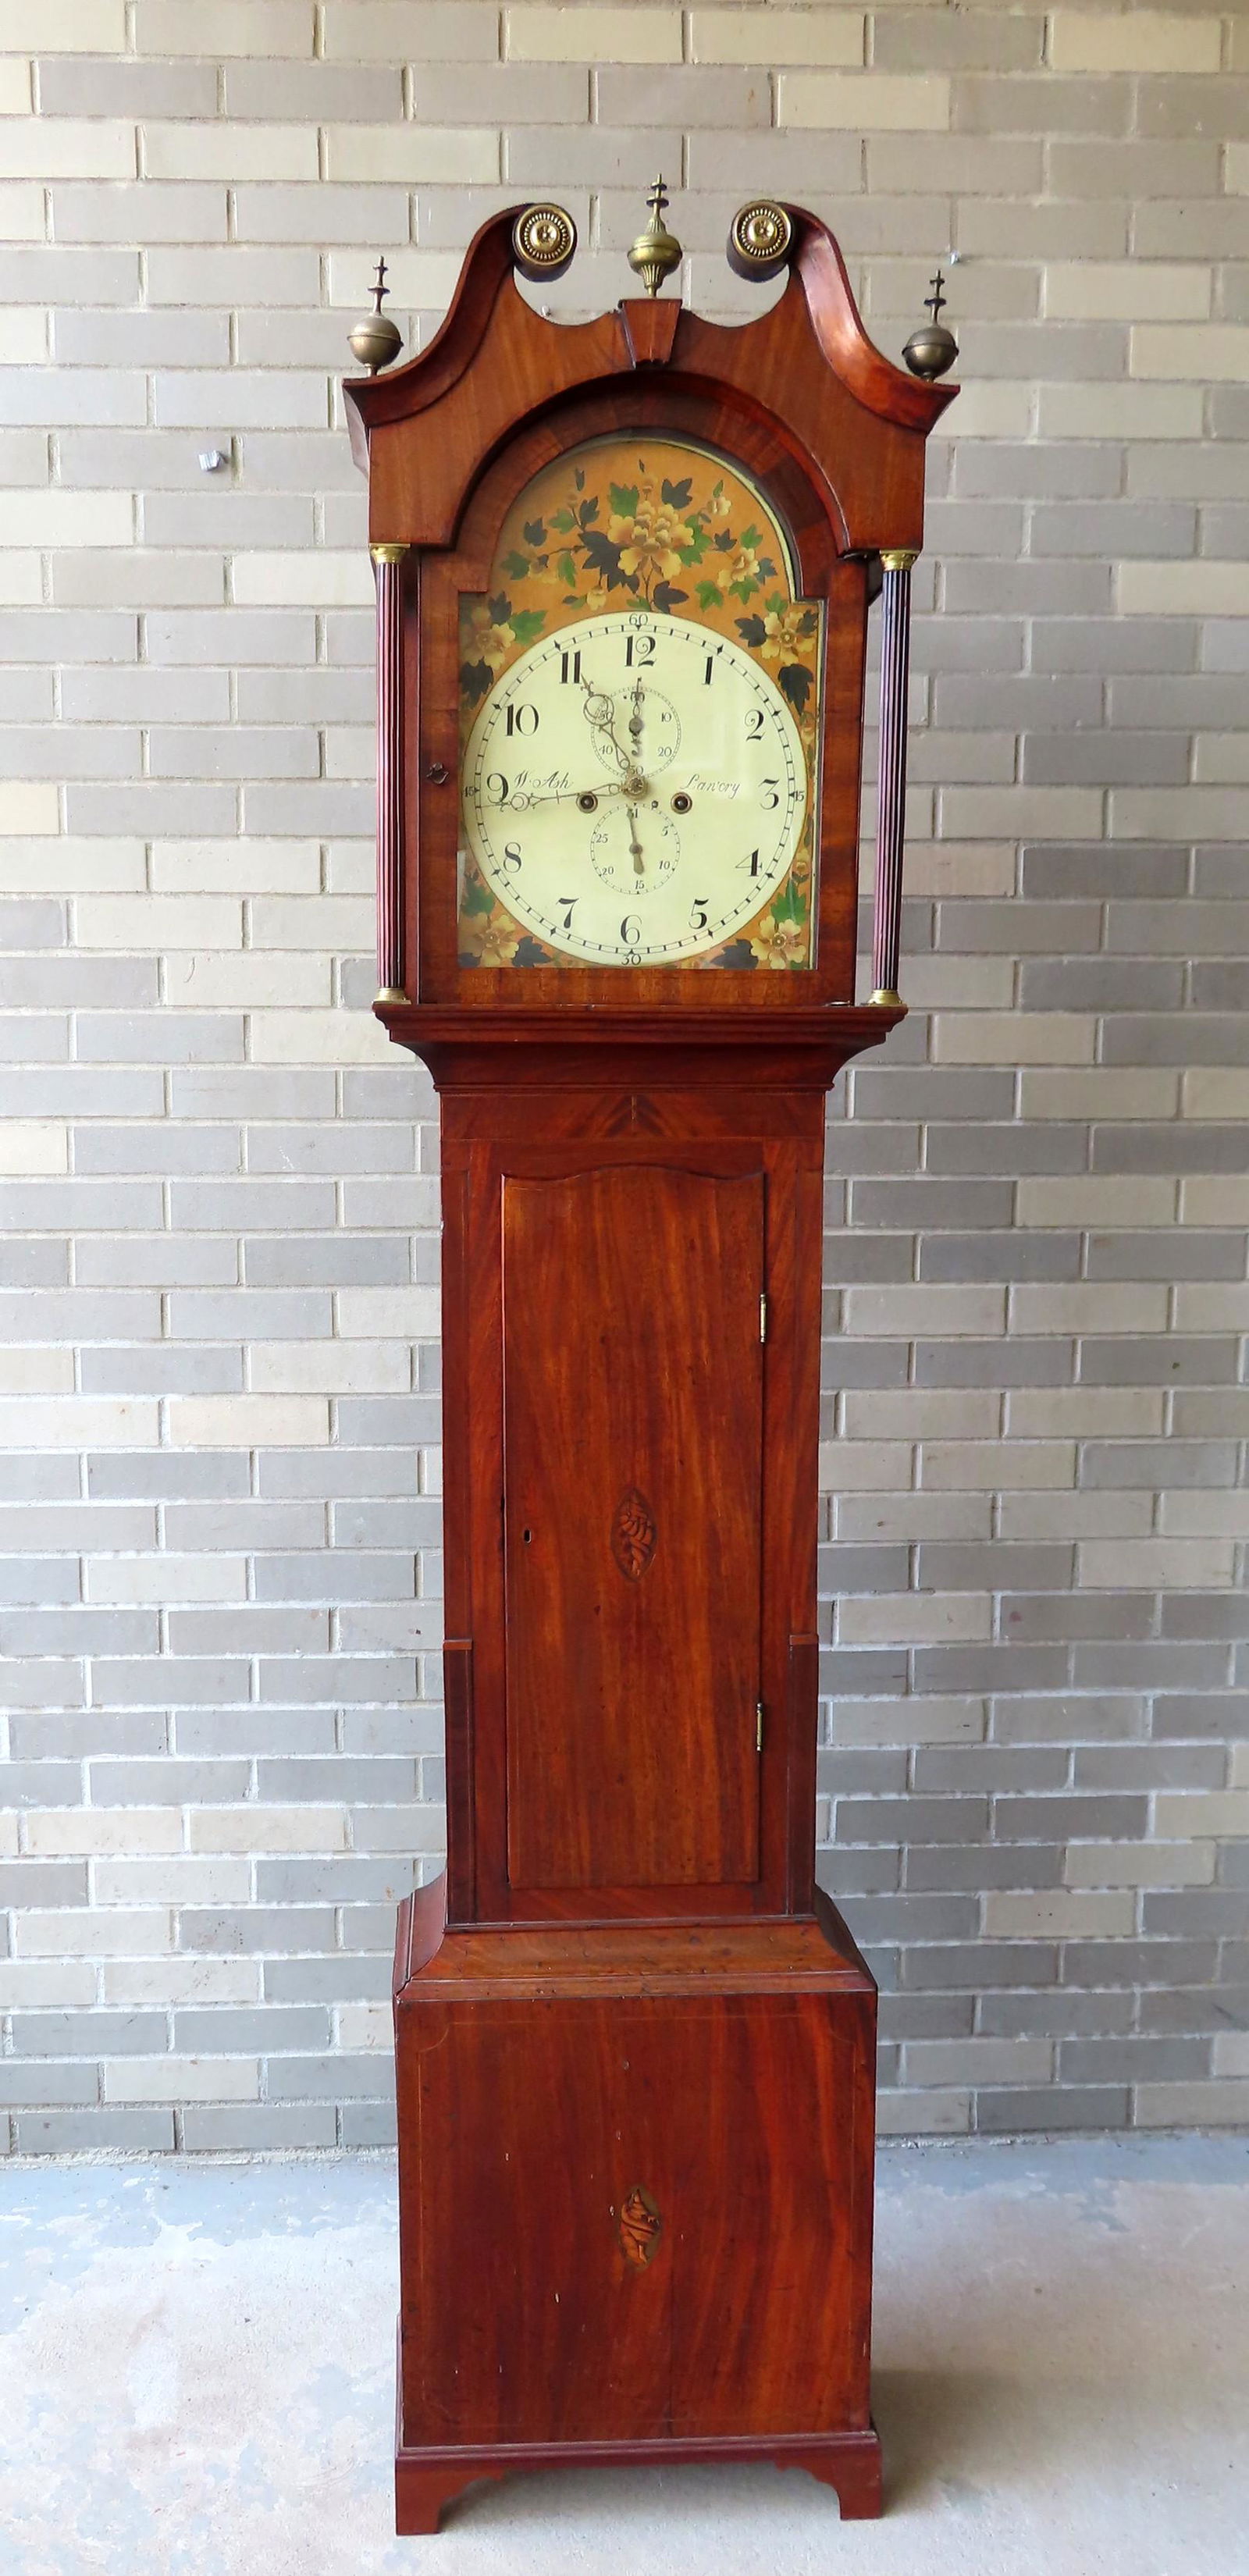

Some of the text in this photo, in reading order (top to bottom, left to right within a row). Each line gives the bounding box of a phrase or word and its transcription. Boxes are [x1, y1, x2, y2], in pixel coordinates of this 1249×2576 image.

[629, 613, 648, 625] 60
[624, 635, 657, 667] 12
[560, 650, 582, 684] 11
[702, 656, 713, 685] 1
[503, 703, 539, 737] 10
[660, 712, 672, 723] 10
[744, 709, 766, 742] 2
[599, 745, 613, 755] 40
[657, 746, 672, 757] 20
[486, 773, 508, 804] 9
[758, 778, 780, 809] 3
[794, 790, 805, 802] 15
[596, 833, 609, 843] 25
[661, 824, 669, 837] 5
[503, 841, 521, 873] 8
[602, 866, 614, 876] 20
[659, 860, 671, 870] 10
[735, 848, 762, 877] 4
[635, 880, 645, 890] 15
[556, 898, 579, 928] 7
[689, 898, 709, 929] 5
[621, 914, 642, 945] 6
[621, 953, 642, 966] 30
